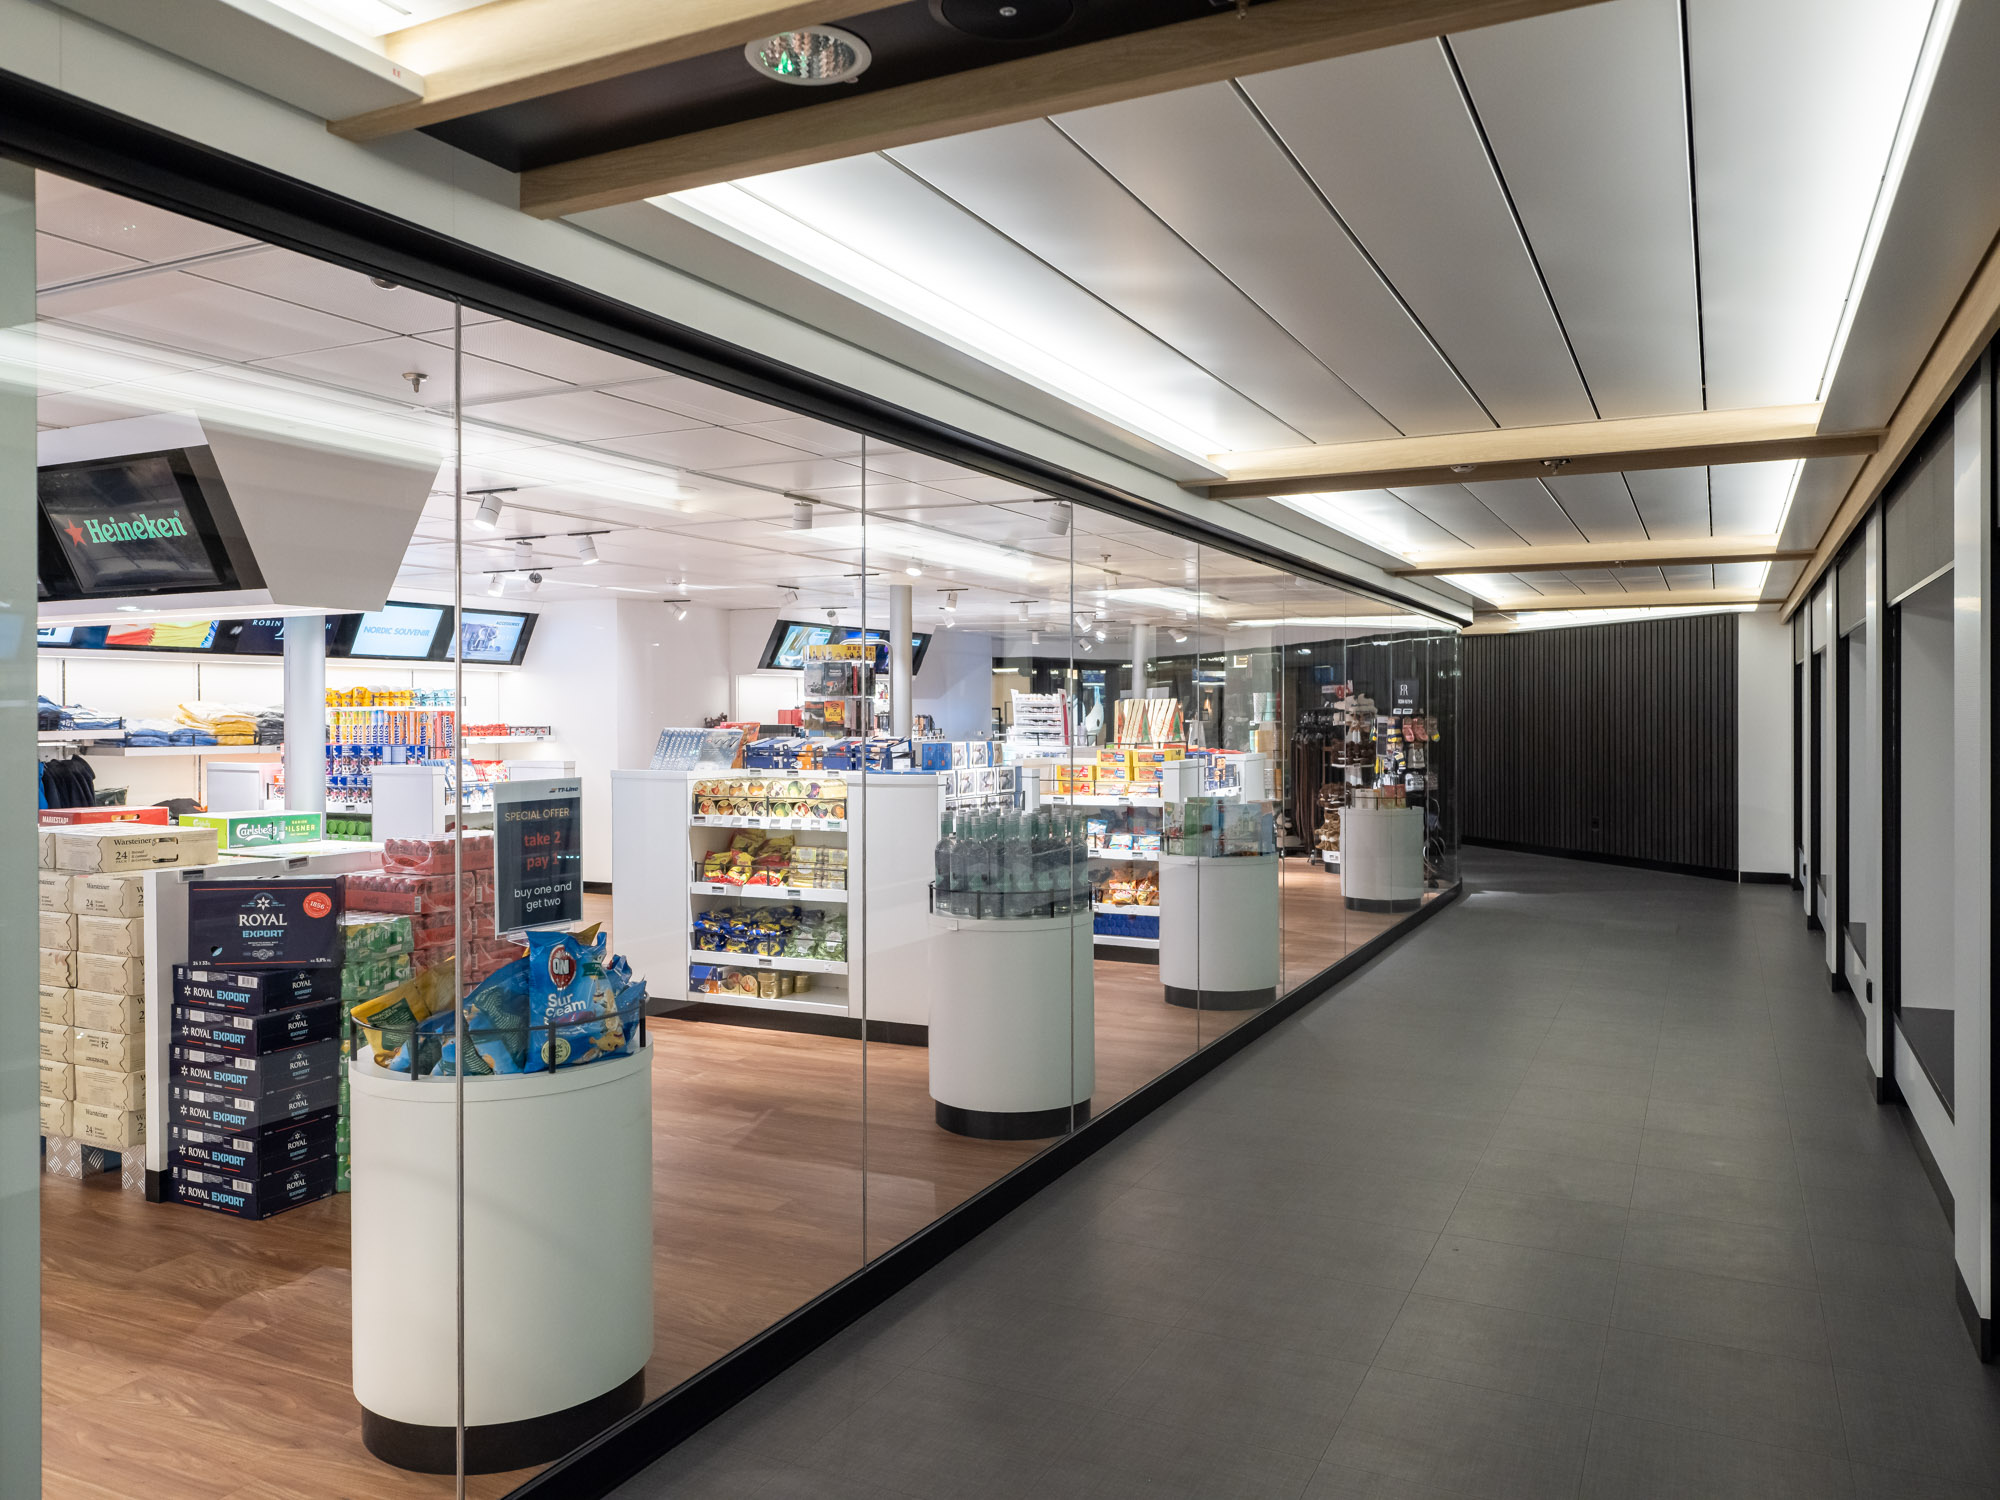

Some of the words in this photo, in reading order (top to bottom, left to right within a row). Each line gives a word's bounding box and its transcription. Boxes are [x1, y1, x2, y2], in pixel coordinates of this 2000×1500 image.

[84, 512, 187, 544] Heineken
[252, 619, 282, 628] ROBIN
[363, 624, 393, 636] NORDIC
[394, 627, 430, 638] SOUVENIR
[504, 810, 541, 822] SPECIAL
[543, 807, 570, 819] OFFER
[113, 837, 152, 846] Warsteiner
[524, 831, 550, 847] take
[553, 831, 561, 844] 2
[115, 851, 128, 860] 24
[526, 855, 549, 872] pay
[552, 852, 560, 865] 1
[514, 887, 532, 899] buy
[534, 884, 551, 895] one
[553, 881, 572, 892] and
[86, 899, 94, 908] 24
[310, 900, 325, 910] 1856
[526, 900, 542, 912] get
[544, 897, 561, 908] two
[239, 913, 288, 927] ROYAL
[242, 929, 285, 938] EXPORT
[292, 979, 312, 989] ROYAL
[193, 987, 215, 999] ROYAL
[216, 990, 251, 1003] EXPORT
[287, 1020, 308, 1030] ROYAL
[190, 1027, 212, 1039] ROYAL
[213, 1031, 246, 1044] EXPORT
[289, 1060, 310, 1070] ROYAL
[190, 1067, 212, 1080] ROYAL
[213, 1071, 249, 1085] EXPORT
[288, 1099, 308, 1110] ROYAL
[189, 1107, 211, 1119] ROYAL
[213, 1111, 247, 1126] EXPORT
[85, 1124, 93, 1133] 24
[287, 1139, 308, 1150] ROYAL
[188, 1147, 210, 1160] ROYAL
[211, 1152, 246, 1166] EXPORT
[286, 1179, 307, 1191] ROYAL
[187, 1187, 210, 1199] ROYAL
[211, 1192, 246, 1207] EXPORT
